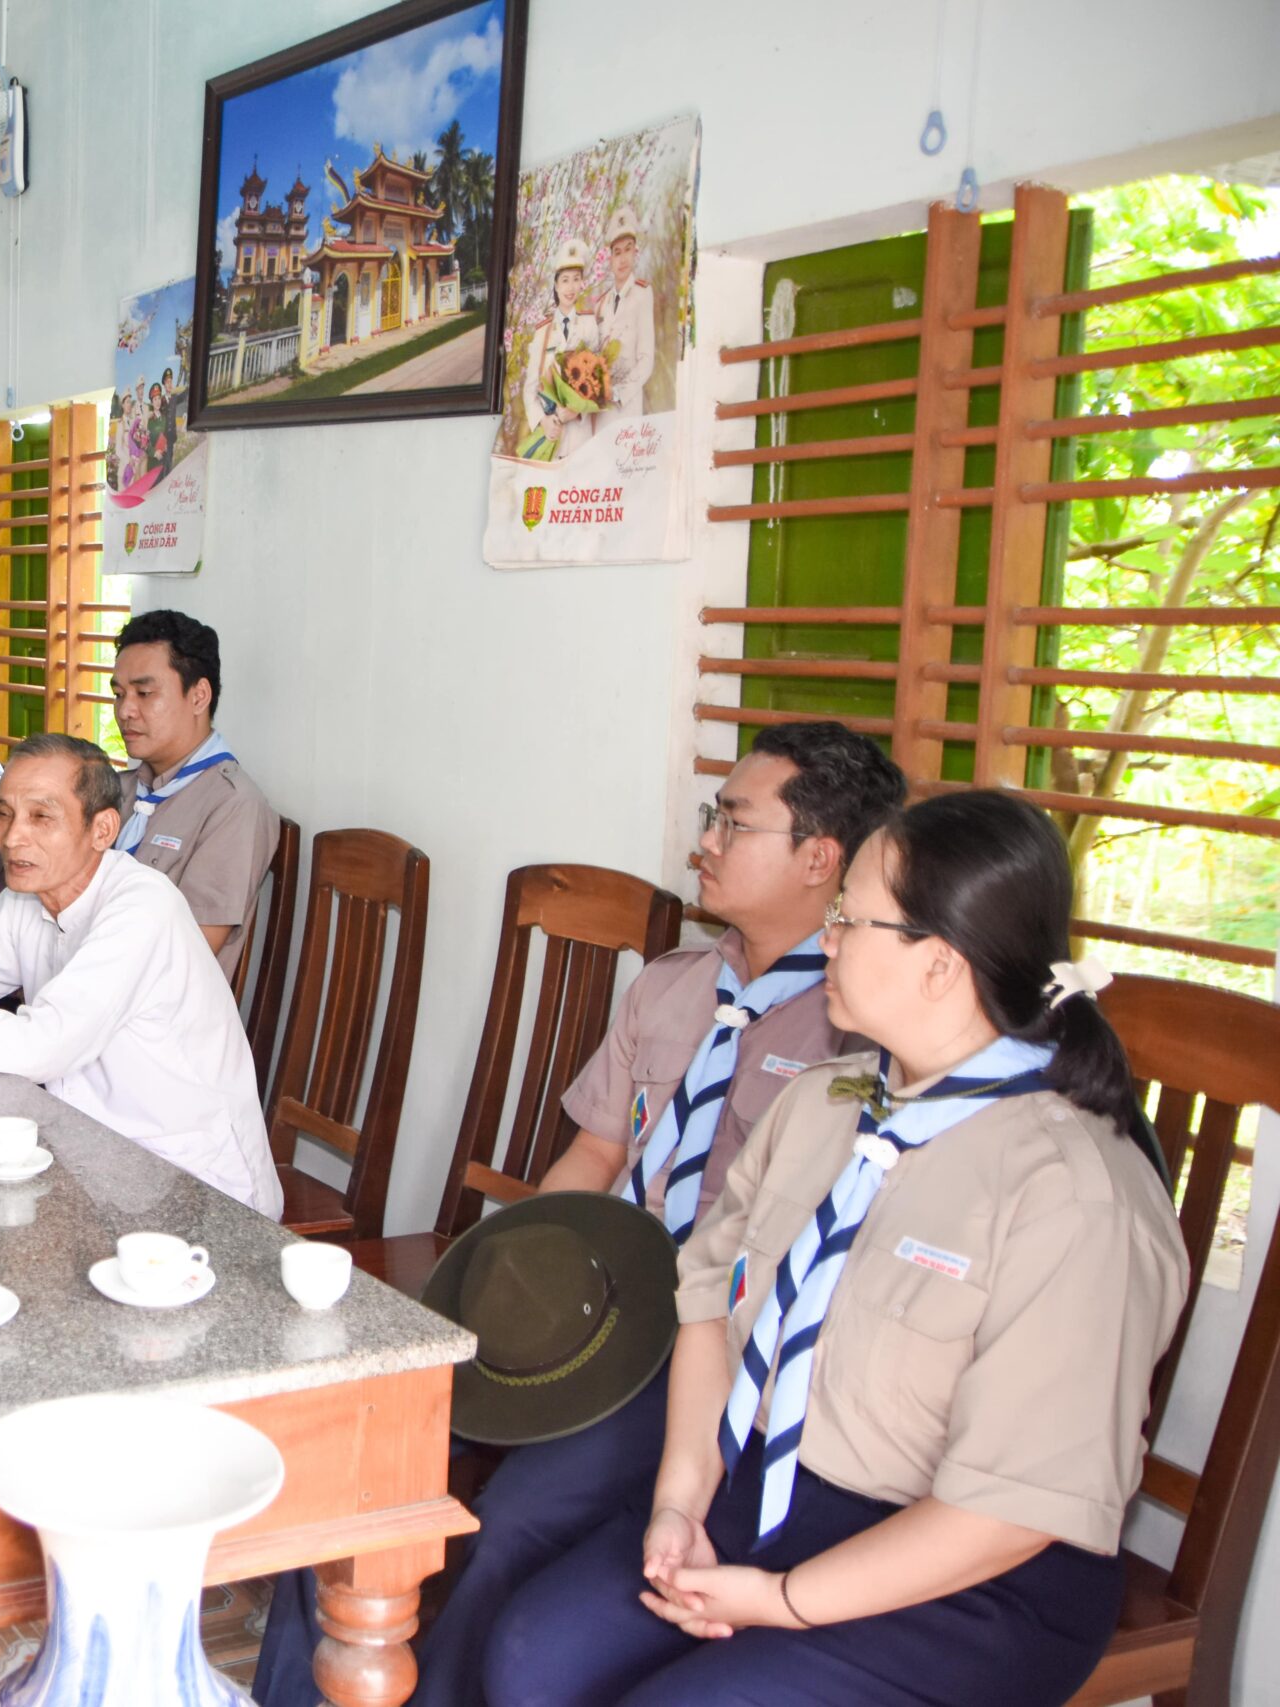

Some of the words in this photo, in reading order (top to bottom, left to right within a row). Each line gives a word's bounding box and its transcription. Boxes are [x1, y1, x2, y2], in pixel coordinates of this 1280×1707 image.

[558, 486, 599, 505] CÔNG
[601, 487, 623, 502] AN
[548, 506, 593, 524] NHÂN
[595, 505, 624, 522] DÂN
[164, 522, 177, 534] AN
